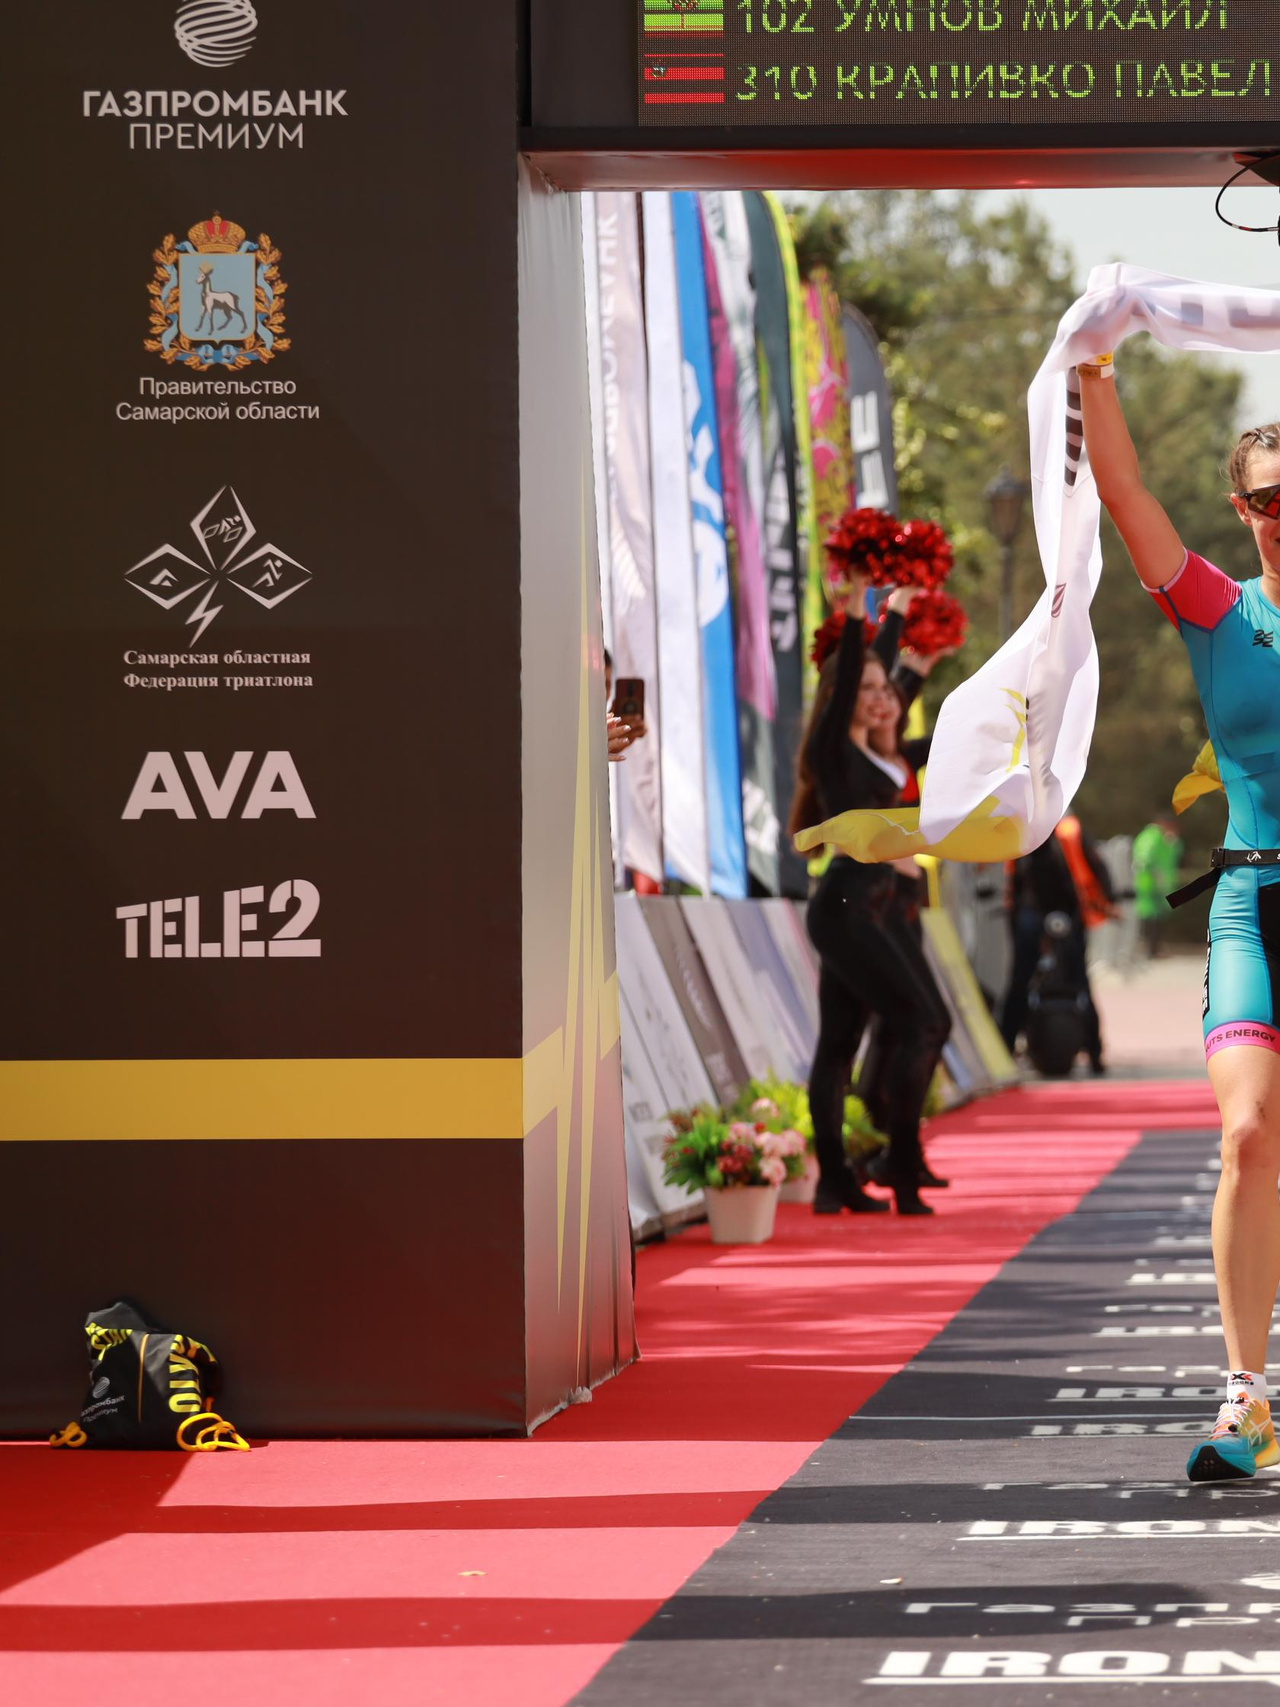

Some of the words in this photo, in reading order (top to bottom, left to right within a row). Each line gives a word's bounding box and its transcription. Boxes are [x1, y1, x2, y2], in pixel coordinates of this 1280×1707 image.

[735, 62, 818, 100] 310
[836, 61, 1096, 99] КРАПИВКО
[1114, 58, 1272, 98] ПАВЕЛ
[82, 89, 349, 117] ГАЗПРОМБАНК
[128, 123, 305, 150] ПРЕМИУМ
[139, 377, 297, 398] Правительство
[115, 402, 230, 425] Самарской
[236, 402, 320, 421] области
[123, 650, 219, 668] Самарская
[223, 650, 311, 664] областная
[123, 673, 219, 691] Федерация
[223, 674, 313, 691] триатлона
[120, 751, 317, 820] AVA
[115, 879, 322, 959] TELE2
[1201, 1033, 1224, 1050] UTS
[1226, 1028, 1276, 1043] ENERGY
